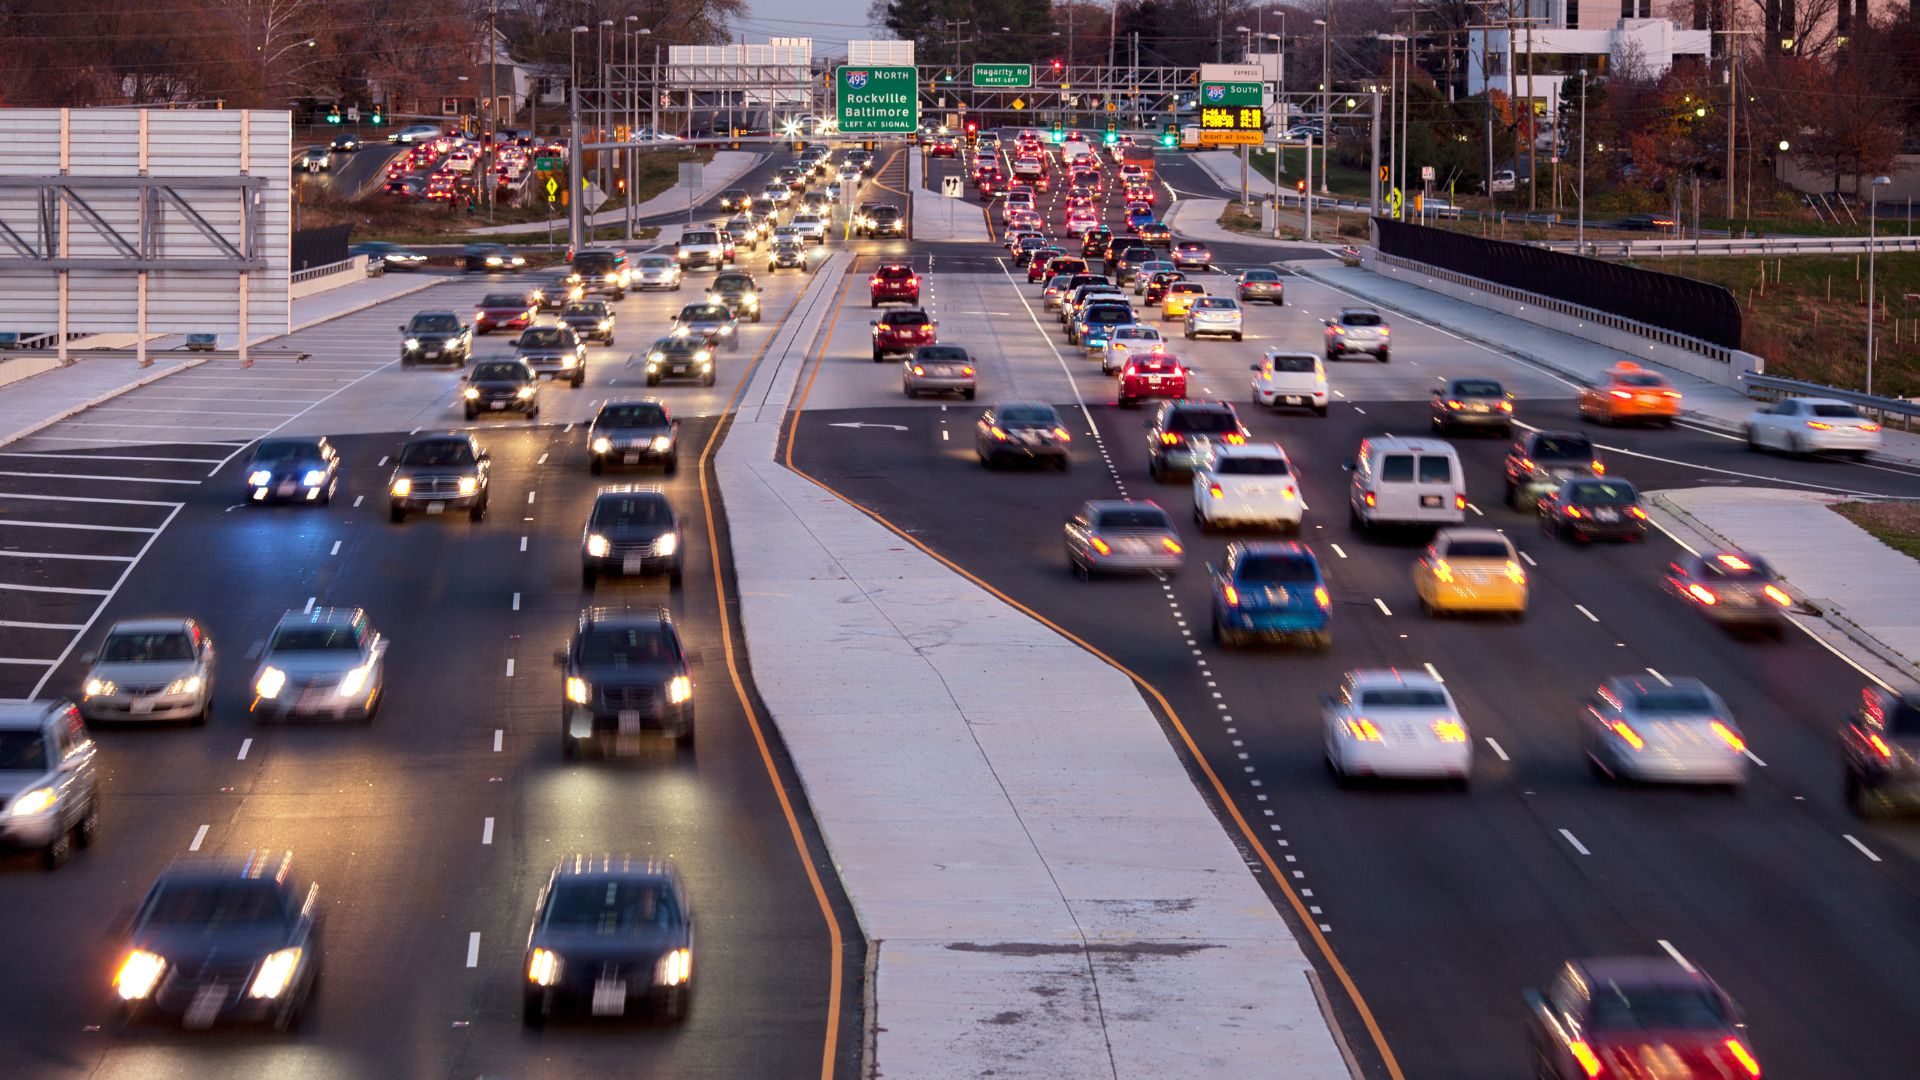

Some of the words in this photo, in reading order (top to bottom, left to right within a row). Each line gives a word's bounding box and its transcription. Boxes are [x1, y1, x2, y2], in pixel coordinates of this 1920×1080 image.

[1017, 68, 1028, 76] Rd
[848, 75, 866, 86] 495
[874, 71, 909, 79] NORTH
[1207, 90, 1224, 99] 495
[1230, 85, 1258, 94] SOUTH
[847, 93, 907, 103] Rockville
[845, 107, 909, 117] Baltimore
